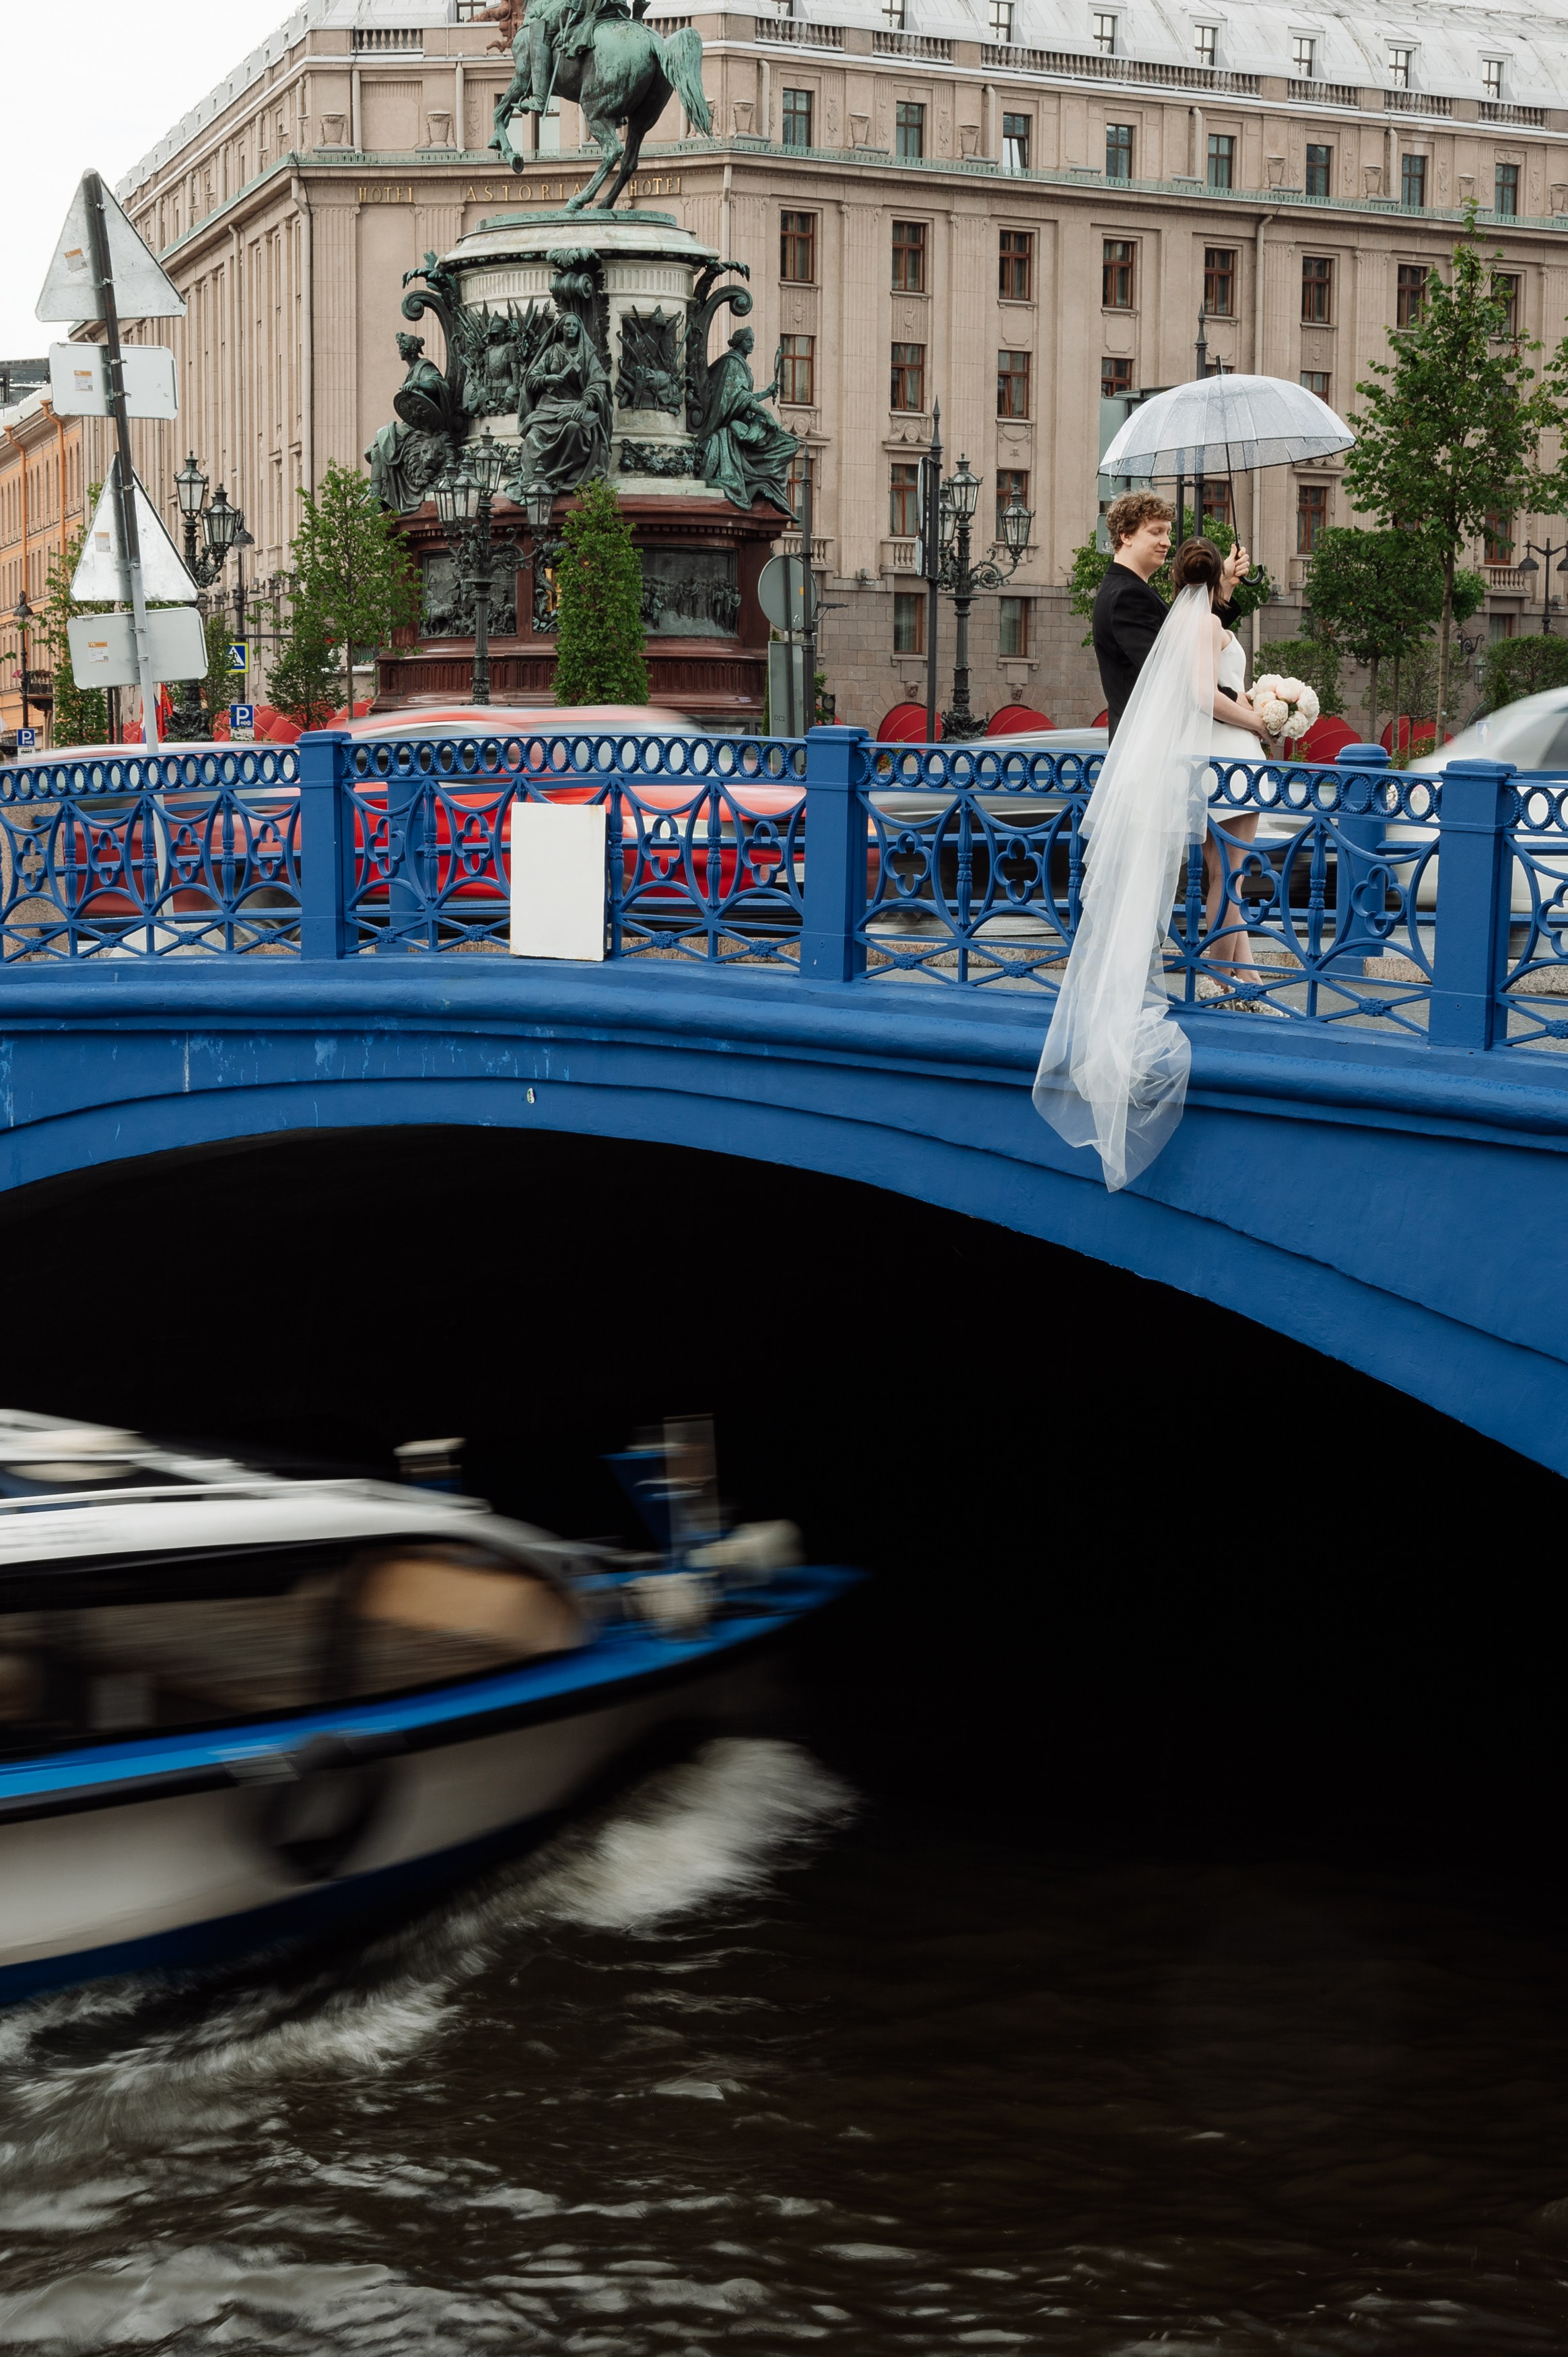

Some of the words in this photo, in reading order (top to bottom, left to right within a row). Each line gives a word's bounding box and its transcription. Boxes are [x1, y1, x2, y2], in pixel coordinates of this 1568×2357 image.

[467, 182, 582, 201] ASTORIA
[236, 707, 249, 725] P
[22, 731, 32, 744] P
